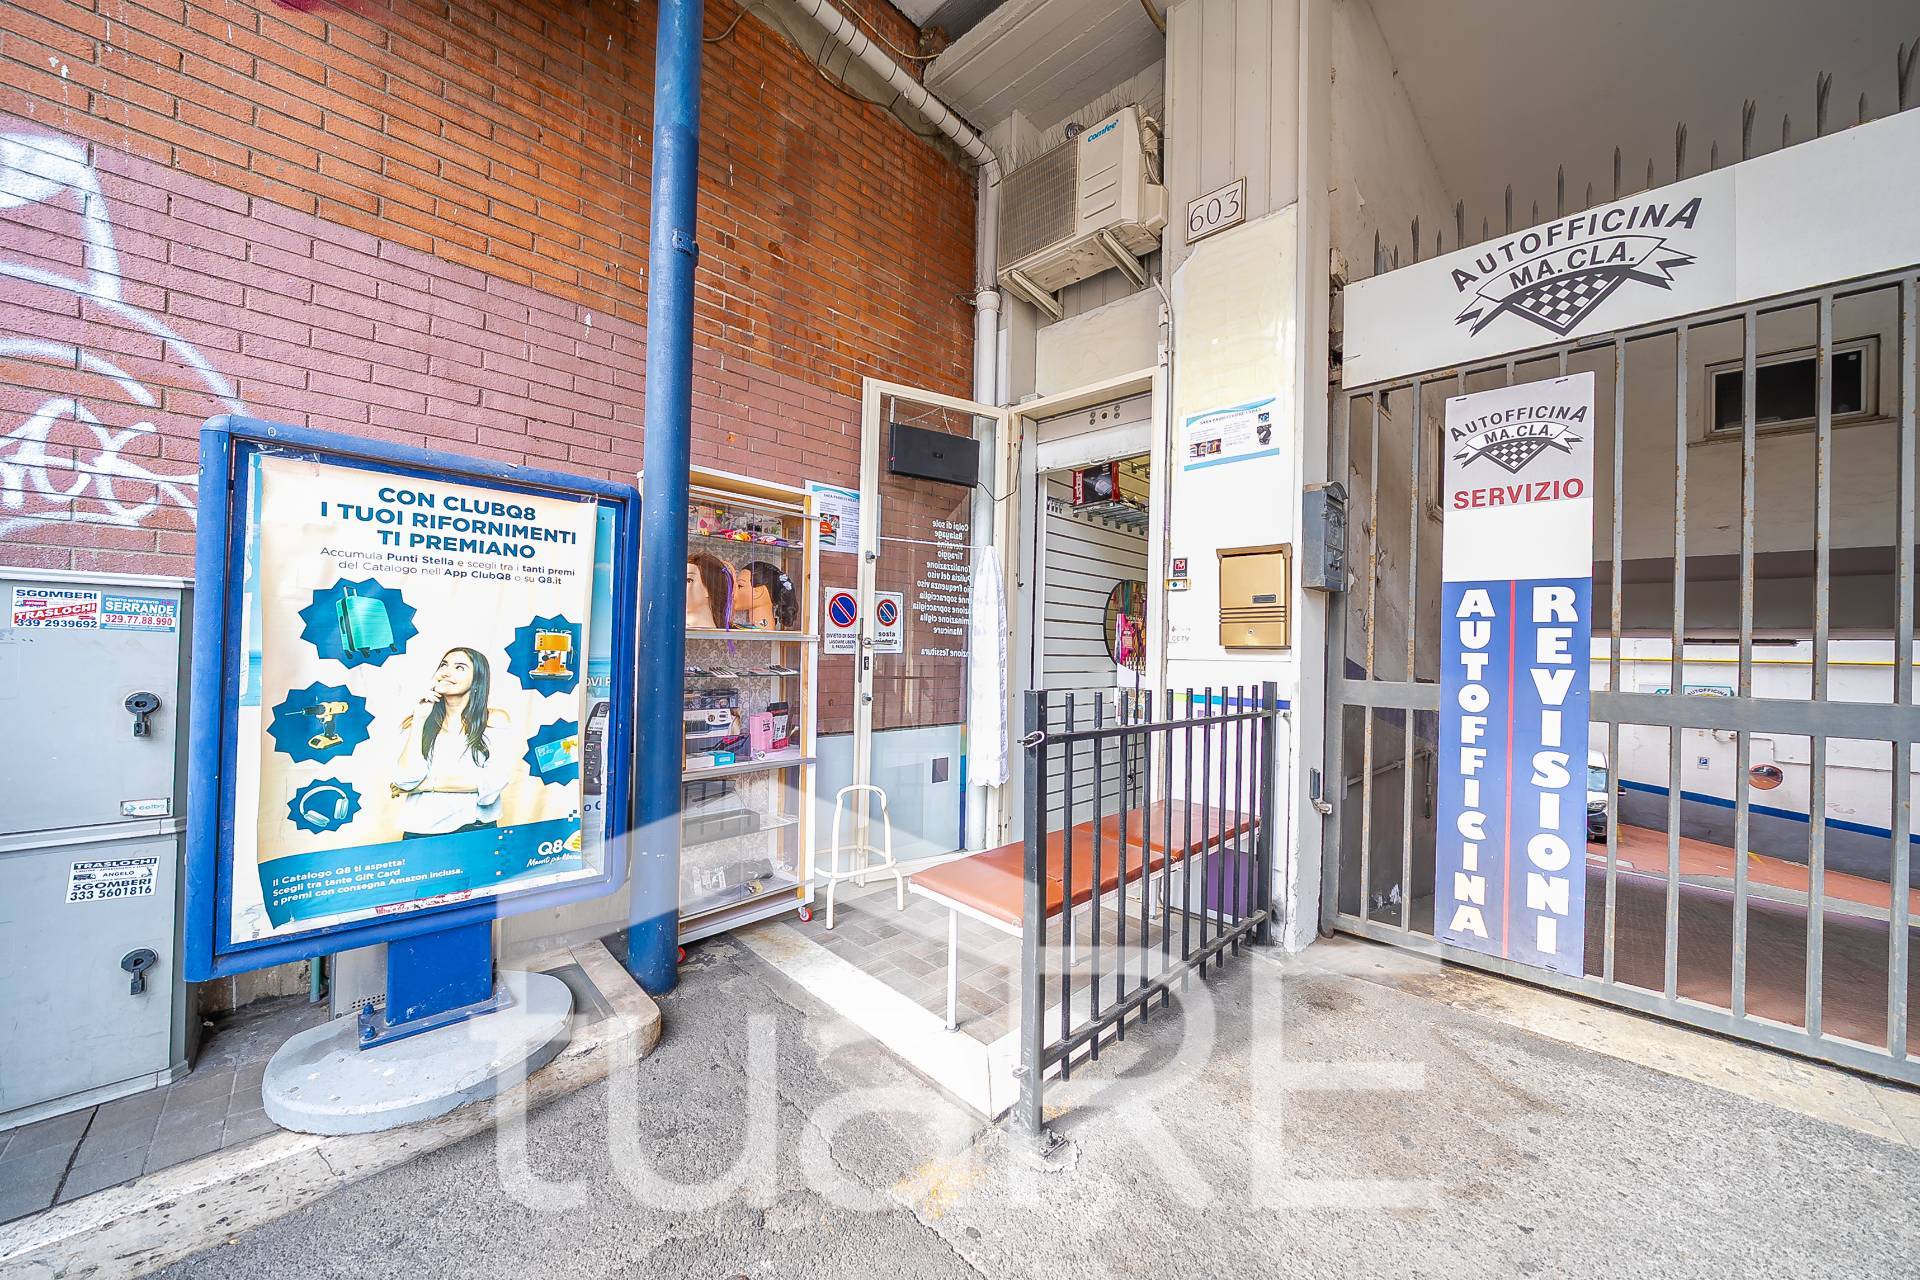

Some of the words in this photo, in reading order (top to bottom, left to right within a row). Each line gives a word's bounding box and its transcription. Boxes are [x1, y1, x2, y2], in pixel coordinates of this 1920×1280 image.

[1088, 119, 1118, 142] comfee
[1190, 188, 1240, 232] 603
[1450, 198, 1702, 292] AUTOFFICINA
[1509, 242, 1635, 290] MA.CLA.
[1450, 405, 1588, 442] AUTOFFICINA
[1484, 424, 1554, 444] MA.CLA.
[378, 487, 435, 508] CON
[443, 496, 536, 521] CLUBQ8
[1453, 478, 1584, 510] SERVIZIO
[321, 501, 328, 517] I
[337, 503, 403, 526] TUOI
[412, 512, 576, 545] RIFORNIMENTI
[377, 529, 400, 546] TI
[410, 532, 536, 559] PREMIANO
[320, 547, 382, 561] Accumula
[387, 552, 418, 564] Punti
[422, 554, 454, 566] Stella
[467, 559, 497, 572] scegli
[500, 562, 514, 572] tra
[522, 564, 545, 574] tanti
[548, 568, 575, 578] premi
[338, 560, 358, 570] del
[362, 561, 418, 575] Catalogo
[471, 569, 512, 581] ClubQ8
[514, 574, 521, 582] o
[524, 575, 535, 584] su
[538, 575, 562, 586] Q8.it
[16, 589, 97, 600] SGOMBERI
[105, 600, 174, 615] SERRANDE
[15, 603, 96, 620] TRASLOCHI
[16, 618, 40, 627] 339
[45, 619, 97, 628] 2939692
[105, 614, 173, 626] 329.77.88.990
[1448, 588, 1496, 939] AUTOFFICINA
[1526, 586, 1578, 955] REVISIONI
[537, 838, 563, 856] Q8
[74, 858, 157, 870] TRASLOCHI
[102, 870, 134, 878] ANGELO
[282, 869, 332, 885] Catalogo
[335, 866, 352, 876] Q8
[354, 864, 362, 872] ti
[364, 858, 406, 873] aspetta!
[70, 890, 94, 901] 333
[98, 885, 152, 898] 5601816
[72, 878, 151, 891] SGOMBERI
[272, 884, 304, 897] Scegli
[307, 879, 322, 888] tra
[324, 876, 352, 887] tante
[354, 872, 374, 883] Gift
[376, 868, 401, 879] Card
[280, 891, 312, 906] premi
[315, 888, 334, 898] con
[337, 880, 386, 894] consegna
[388, 873, 428, 886] Amazon
[429, 868, 464, 879] inclusa.
